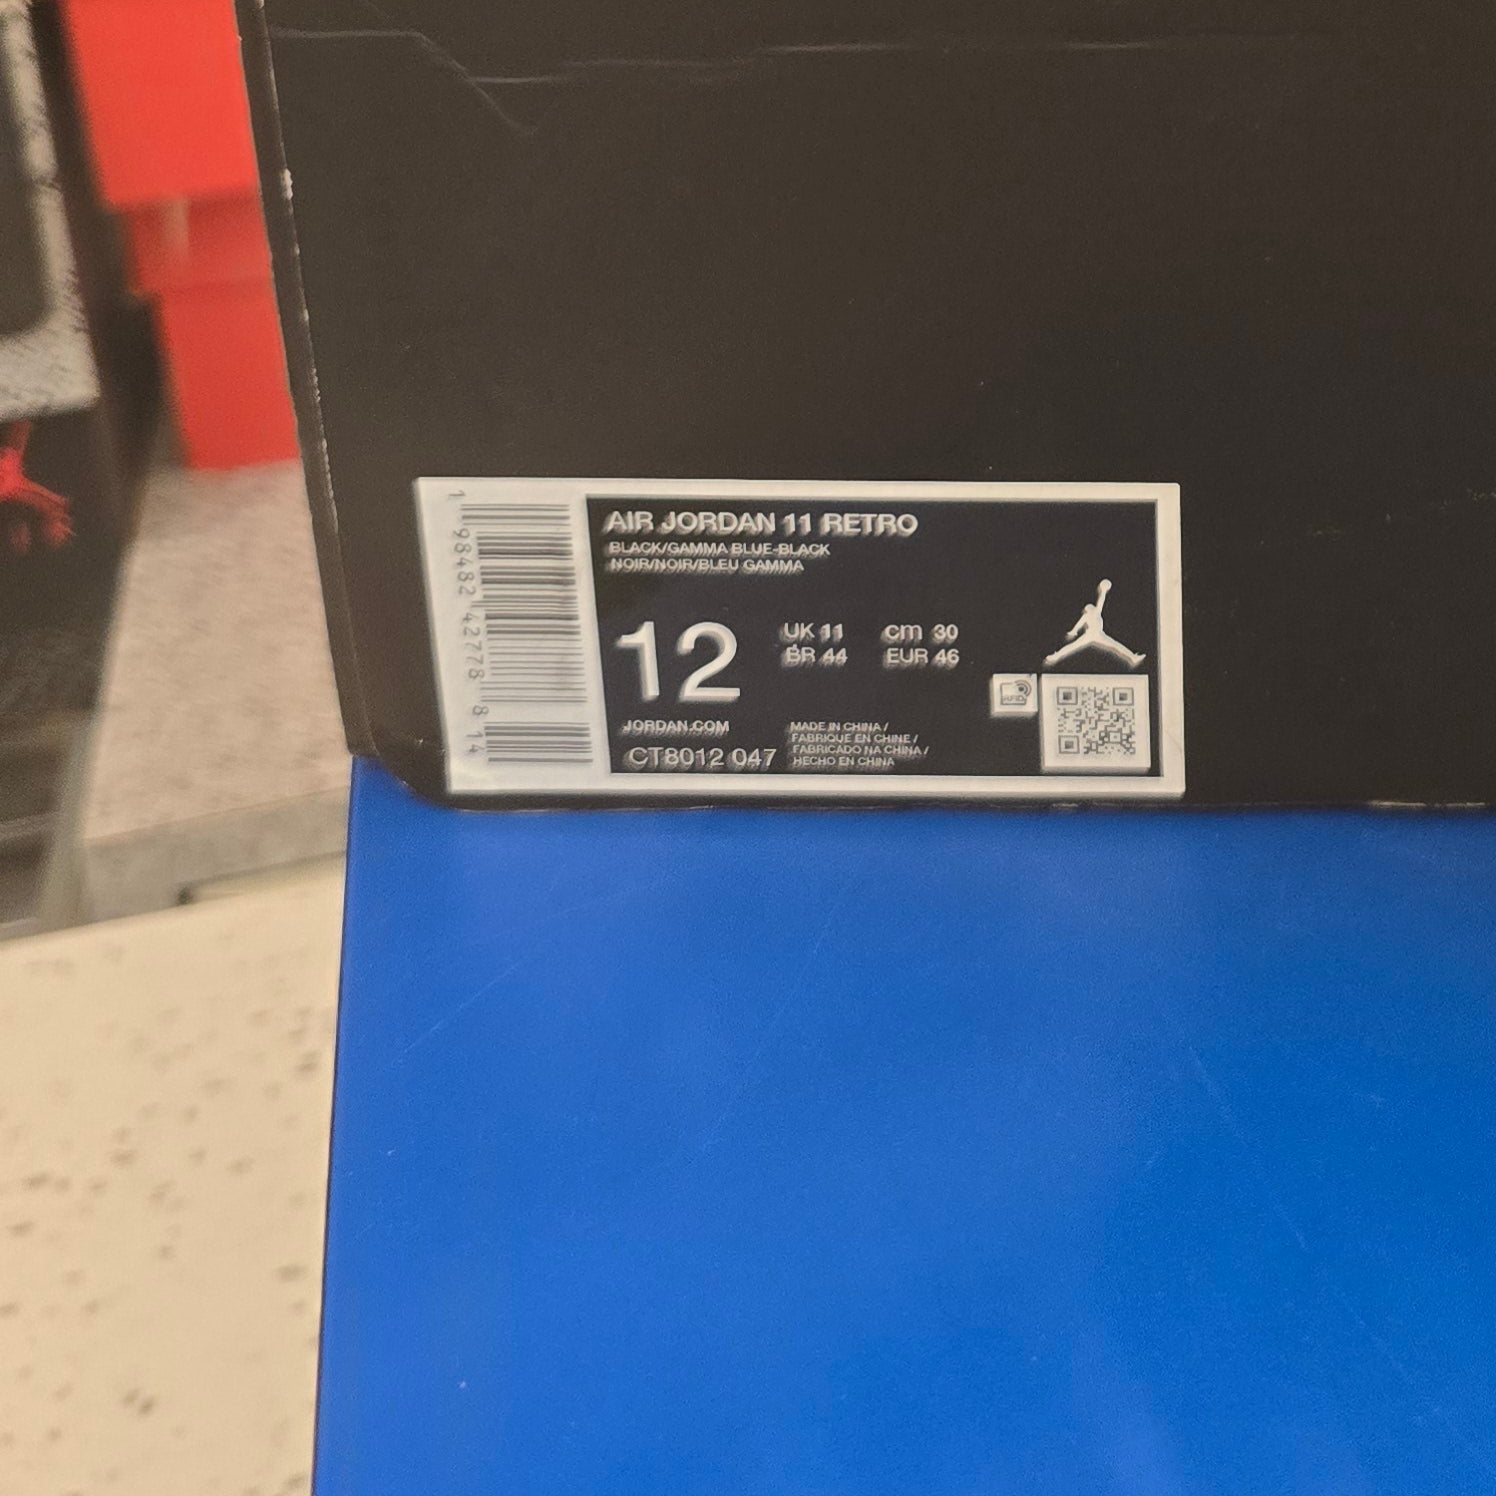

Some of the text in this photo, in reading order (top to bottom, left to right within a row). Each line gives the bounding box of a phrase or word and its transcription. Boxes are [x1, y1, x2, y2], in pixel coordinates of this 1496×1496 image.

[604, 510, 919, 536] AIR JORDAN 11 RETRO
[607, 541, 831, 558] BLACK/GAMMA BLUE-BLACK
[452, 527, 477, 596] 98482
[608, 558, 804, 574] NOIR/NOIR/BLEU GAMMA
[781, 622, 844, 643] UK 11
[881, 623, 959, 643] cm 30
[463, 611, 487, 680] 42778
[616, 620, 741, 702] 12
[782, 646, 848, 667] BR 44
[883, 647, 960, 668] EUR 46
[472, 704, 490, 717] 8
[621, 719, 730, 735] JORDAN.COM
[789, 721, 826, 733] MADE
[828, 722, 841, 732] IN
[842, 721, 881, 733] CHINA
[466, 730, 487, 755] 14
[789, 733, 852, 744] FABRIQUE
[854, 733, 872, 744] EN
[873, 733, 911, 744] CHINE
[626, 746, 777, 769] CT8012 047
[791, 744, 862, 755] FABRICADO
[864, 745, 884, 755] NA
[885, 745, 923, 756] CHINA
[791, 756, 895, 768] HECHO EN CHINA
